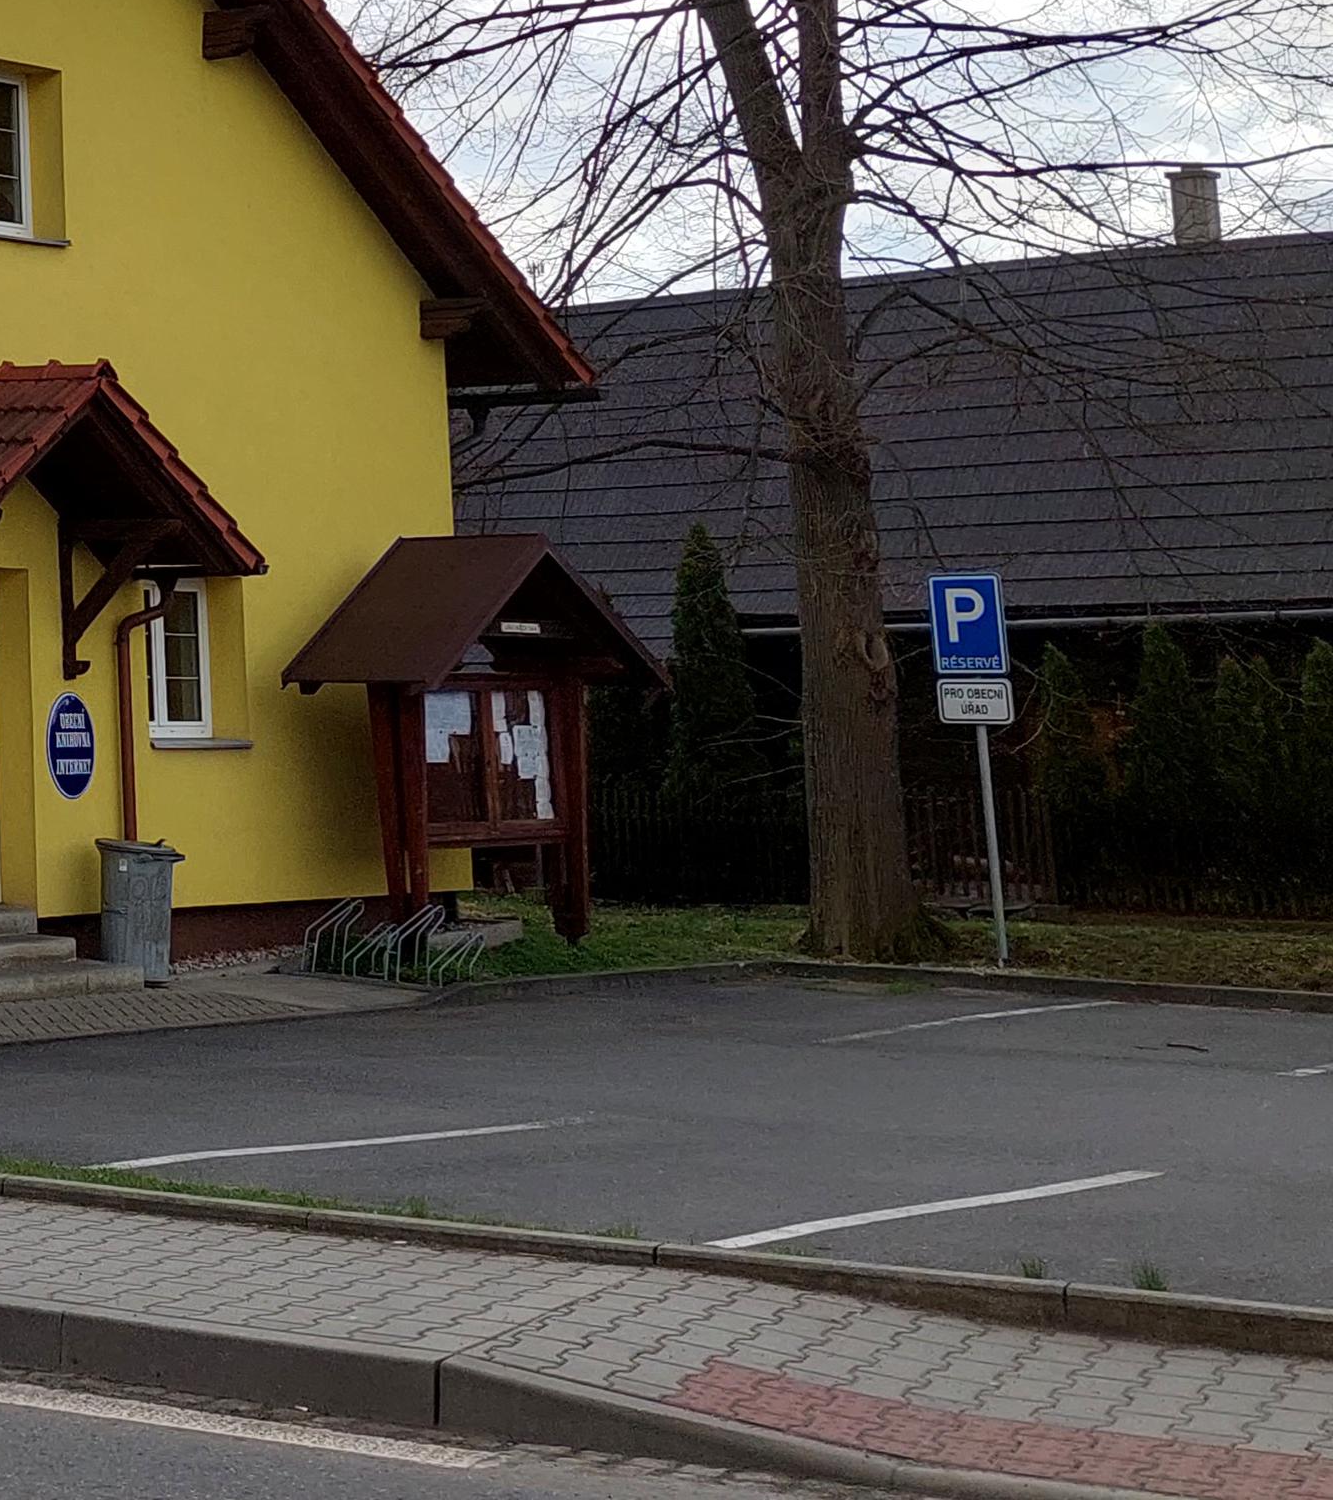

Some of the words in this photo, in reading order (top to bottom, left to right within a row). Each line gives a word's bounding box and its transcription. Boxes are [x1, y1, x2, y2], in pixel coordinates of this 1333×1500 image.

[944, 587, 985, 643] P
[941, 655, 1000, 669] RÉSERVÉ
[944, 688, 964, 699] PRO
[967, 687, 1003, 700] OBECNÍ
[961, 700, 988, 715] ÚŘAD
[55, 731, 91, 748] KNIHOVNA
